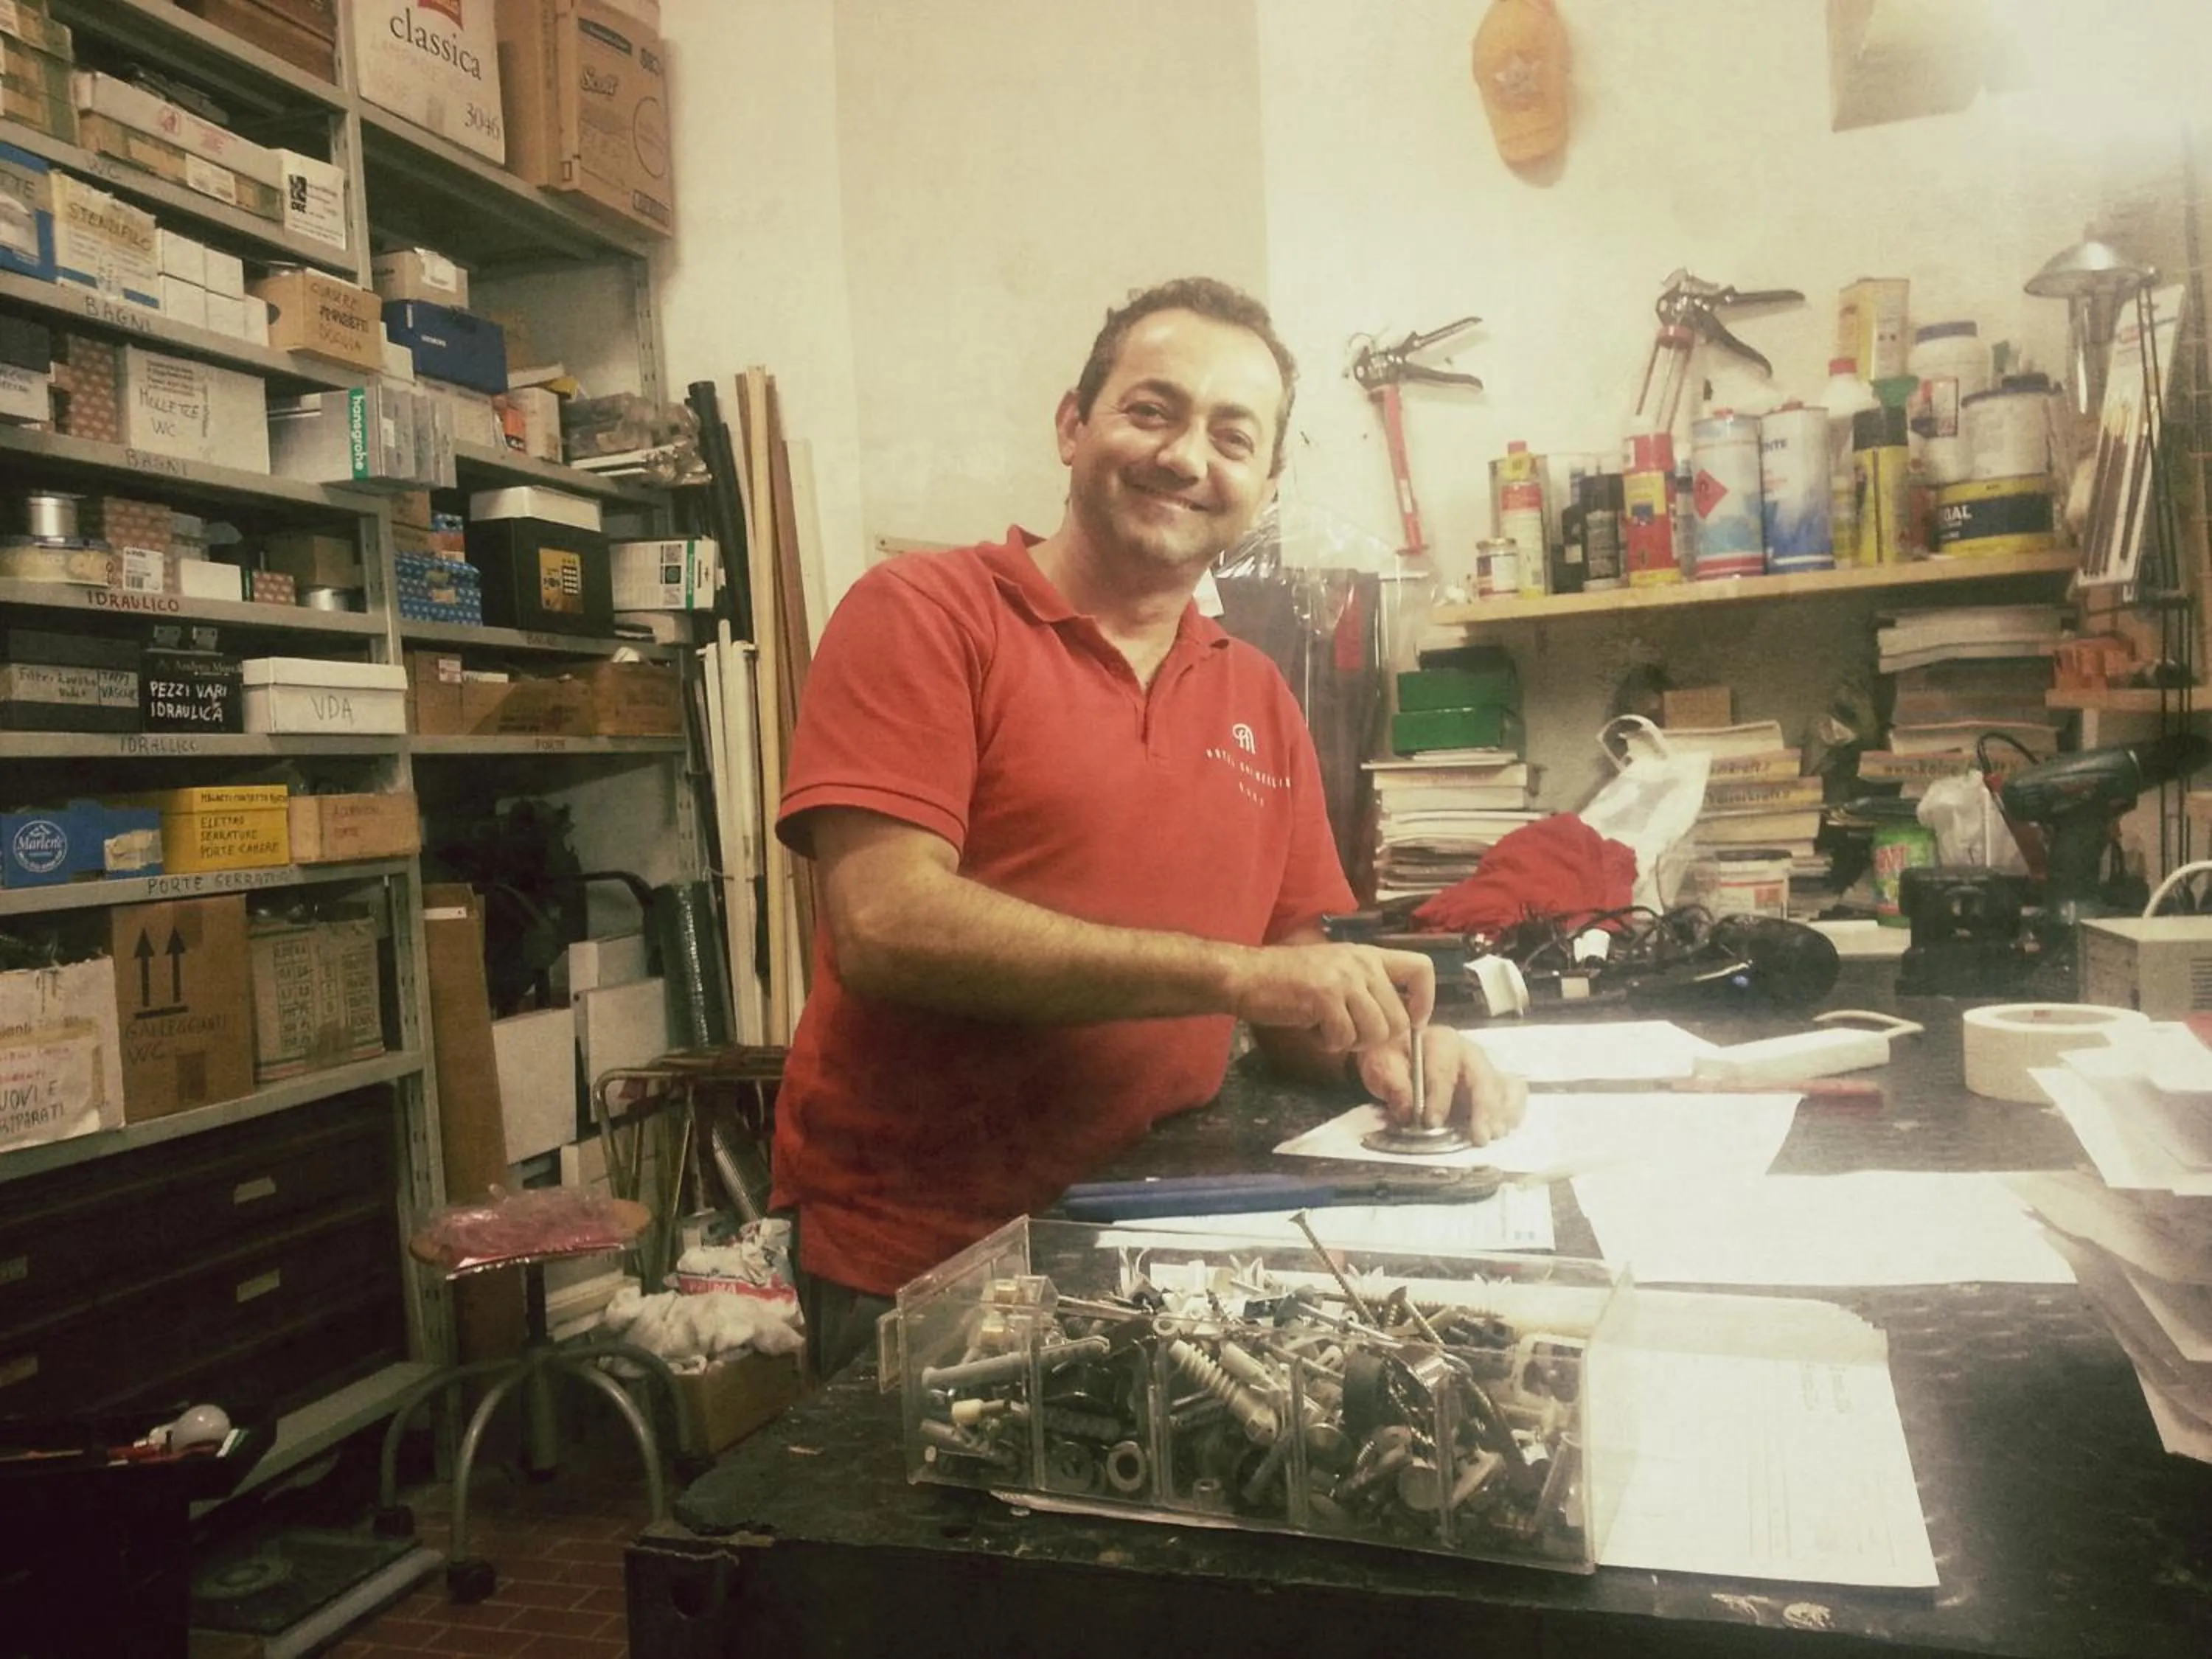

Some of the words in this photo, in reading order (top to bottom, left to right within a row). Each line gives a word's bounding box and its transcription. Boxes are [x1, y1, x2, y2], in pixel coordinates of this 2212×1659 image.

[390, 7, 481, 80] classica
[86, 296, 152, 332] BAGNI
[150, 417, 175, 437] WC
[352, 394, 366, 472] hansgrohe
[126, 448, 188, 477] BAGNI
[88, 591, 179, 612] IDRAULICO
[150, 681, 189, 698] PEZZI
[195, 684, 227, 699] VARI
[151, 701, 223, 723] IDRAULICA
[311, 695, 354, 724] VDA
[200, 844, 234, 859] PORTE
[148, 876, 203, 896] PORTE
